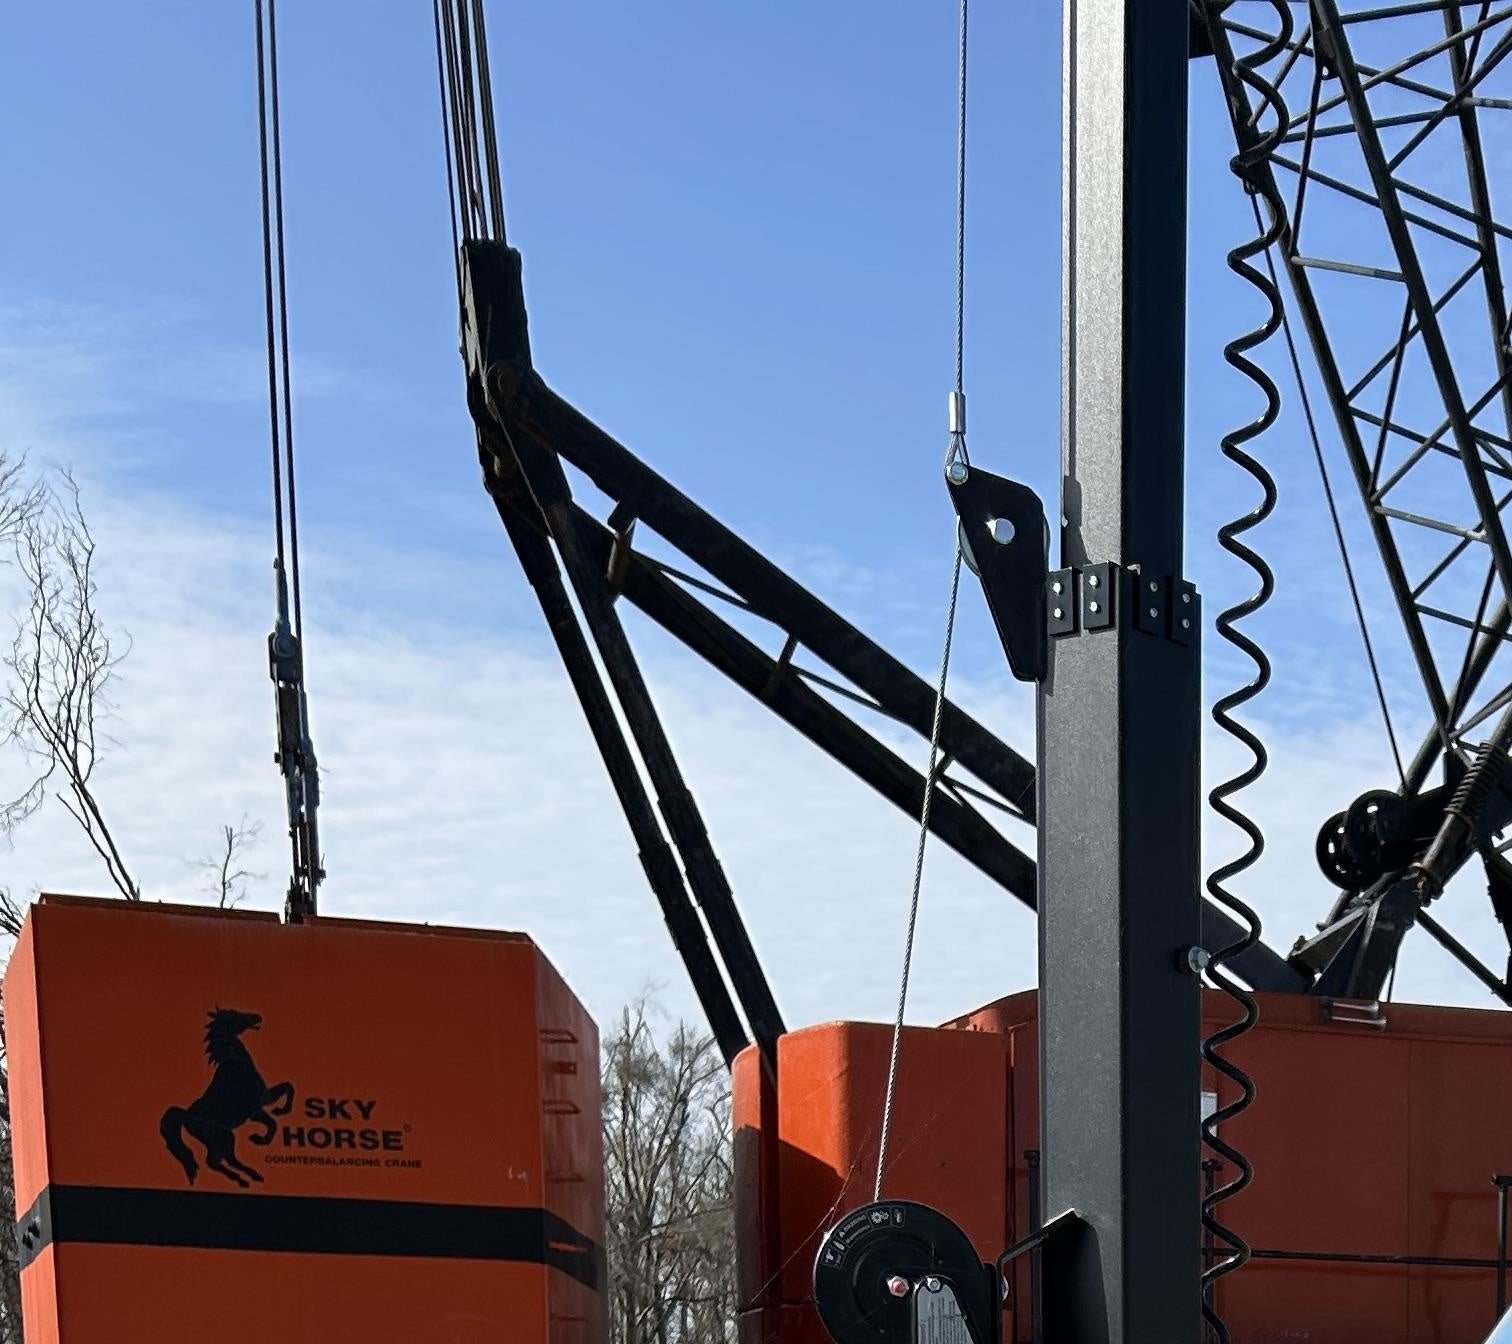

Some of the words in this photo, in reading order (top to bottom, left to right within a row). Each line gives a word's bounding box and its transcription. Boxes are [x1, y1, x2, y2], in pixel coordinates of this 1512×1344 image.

[305, 1097, 376, 1120] SKY
[282, 1126, 403, 1151] HORSE
[265, 1154, 380, 1167] COUNTERBALANCING
[385, 1158, 421, 1168] CRANE
